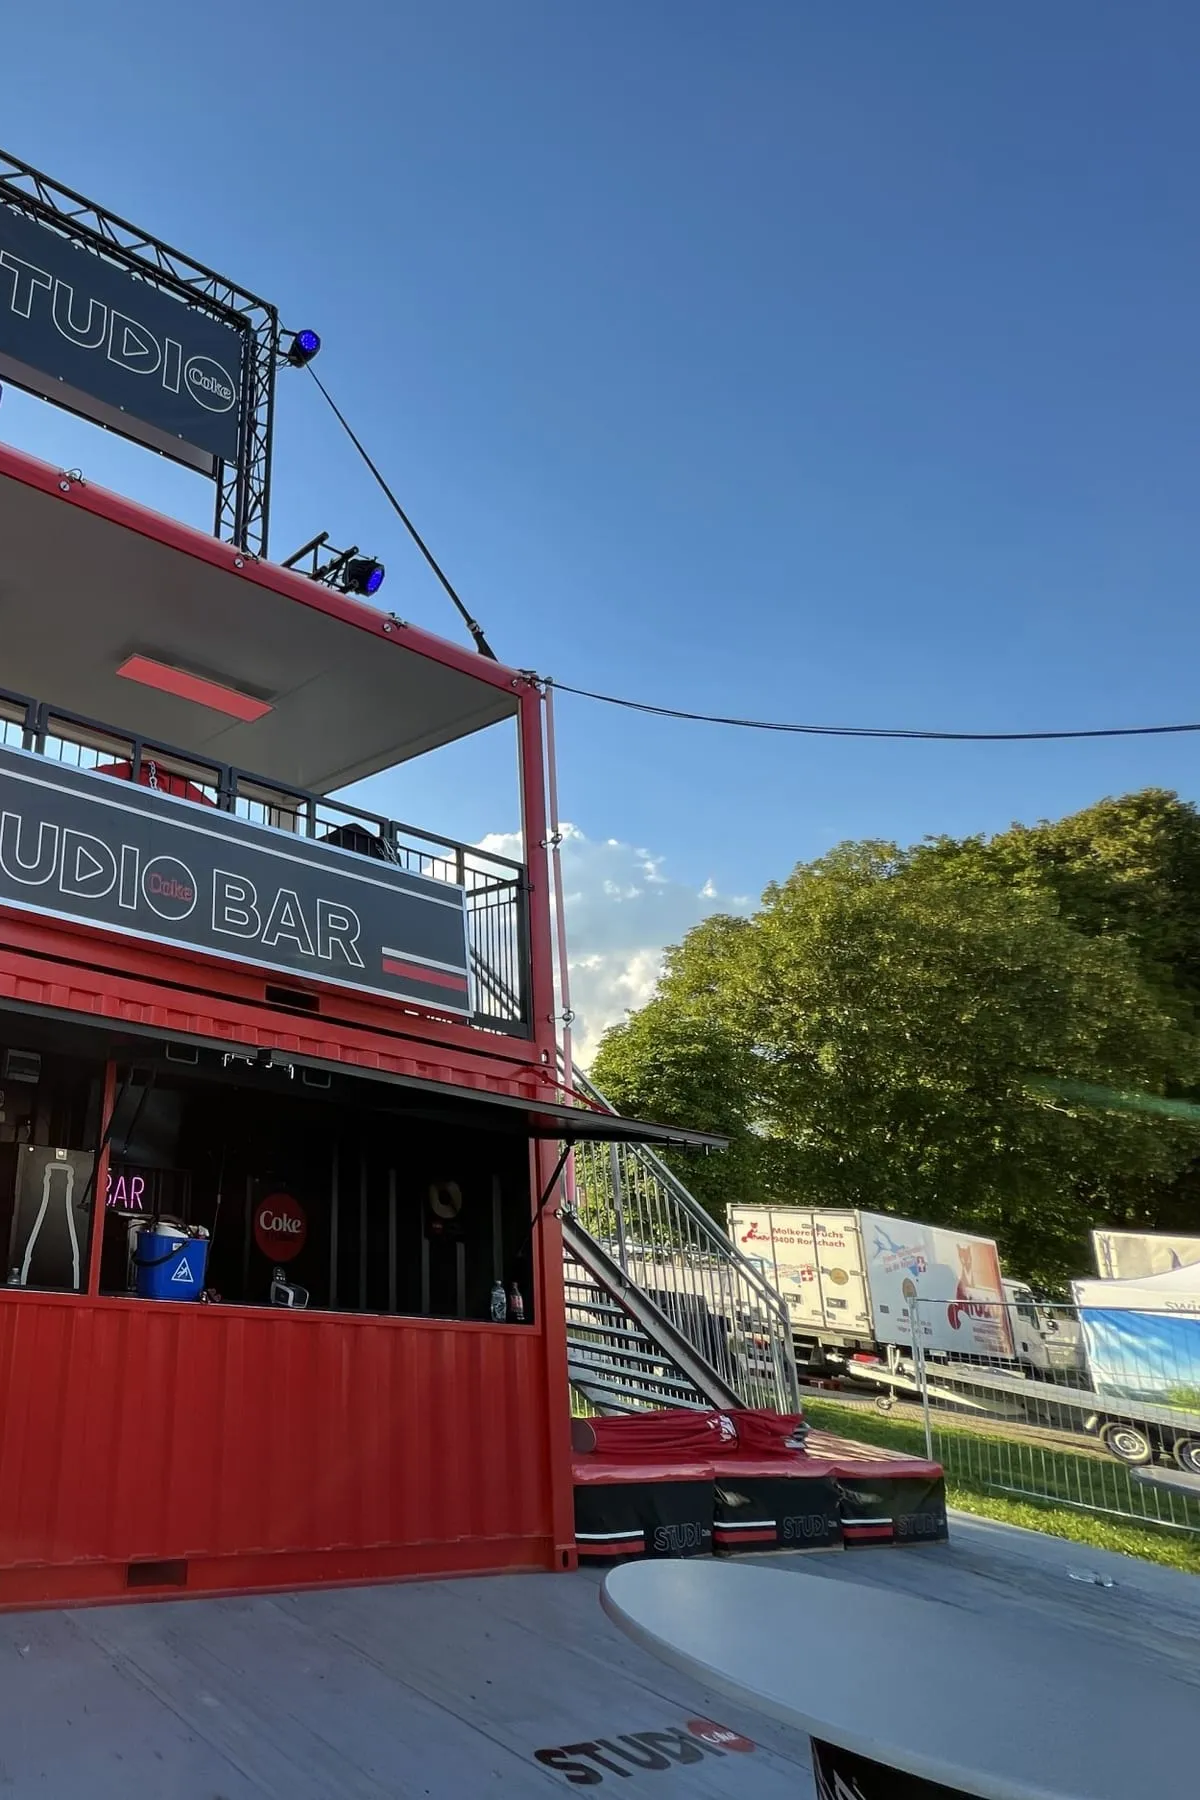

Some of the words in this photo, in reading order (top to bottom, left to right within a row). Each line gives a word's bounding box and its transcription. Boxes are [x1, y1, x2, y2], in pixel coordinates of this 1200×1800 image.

[188, 366, 232, 401] Coke
[149, 872, 194, 903] Coke
[212, 869, 365, 969] BAR
[259, 1210, 302, 1234] Coke
[797, 1237, 846, 1248] Rorchach
